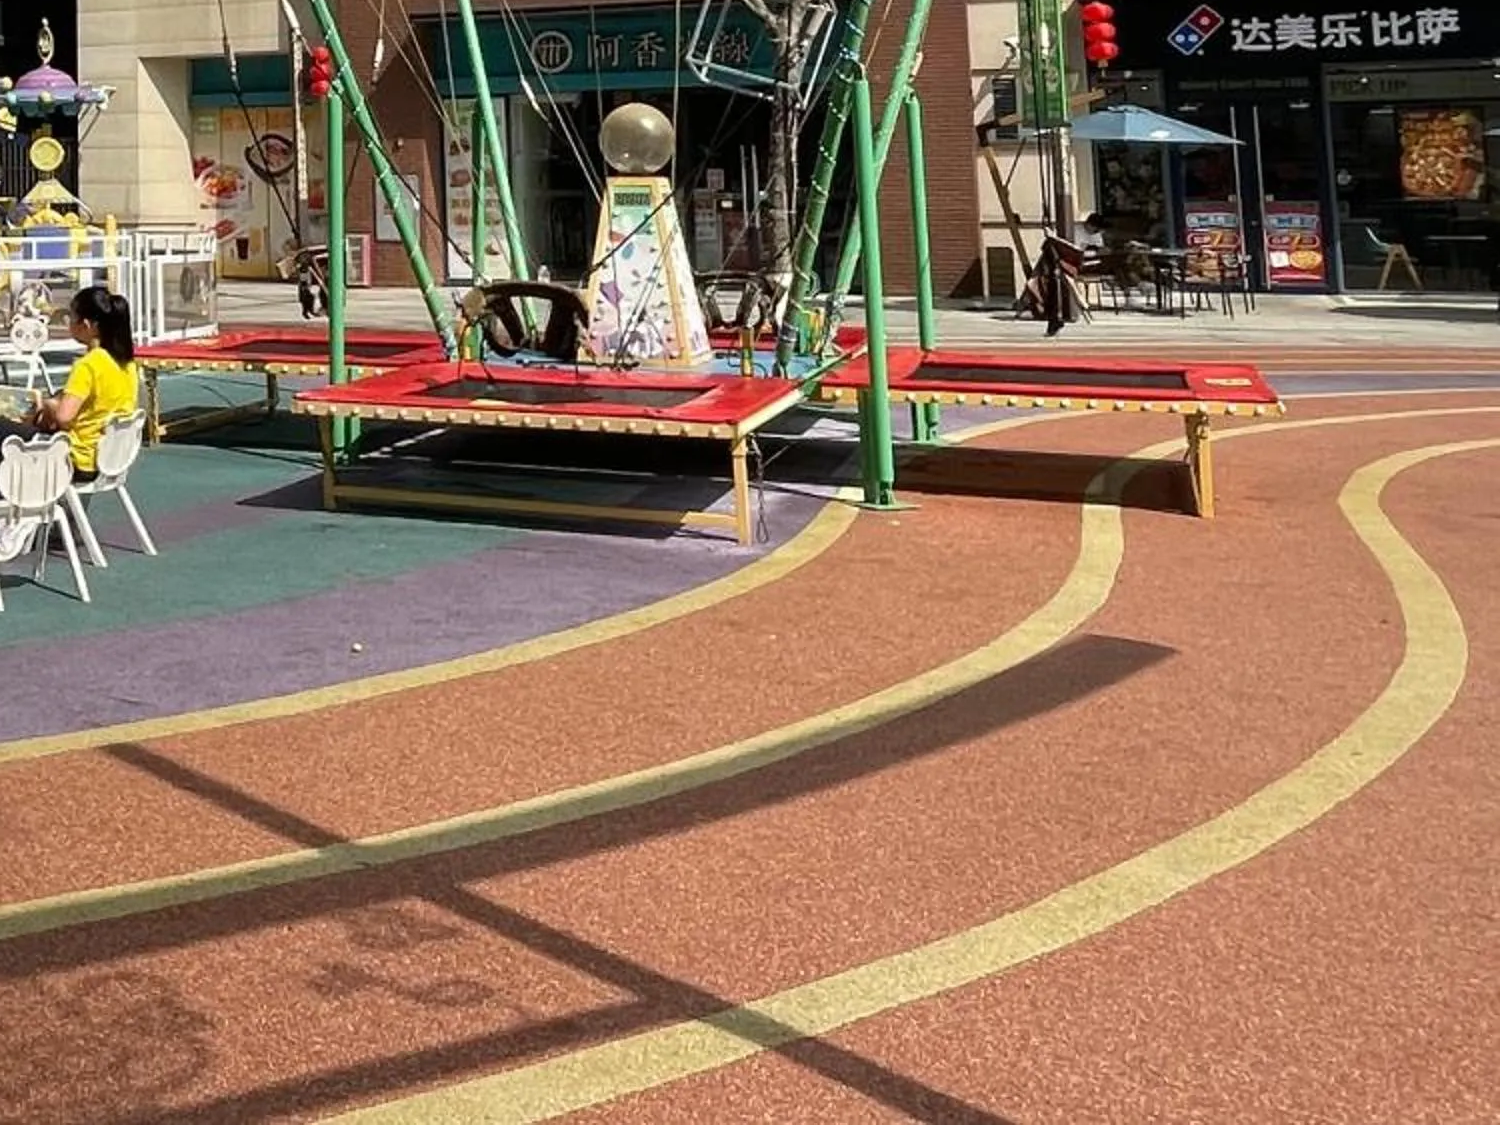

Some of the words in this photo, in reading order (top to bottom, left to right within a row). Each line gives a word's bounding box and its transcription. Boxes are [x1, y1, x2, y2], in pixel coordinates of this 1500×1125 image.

[1231, 7, 1461, 52] 达美乐比萨
